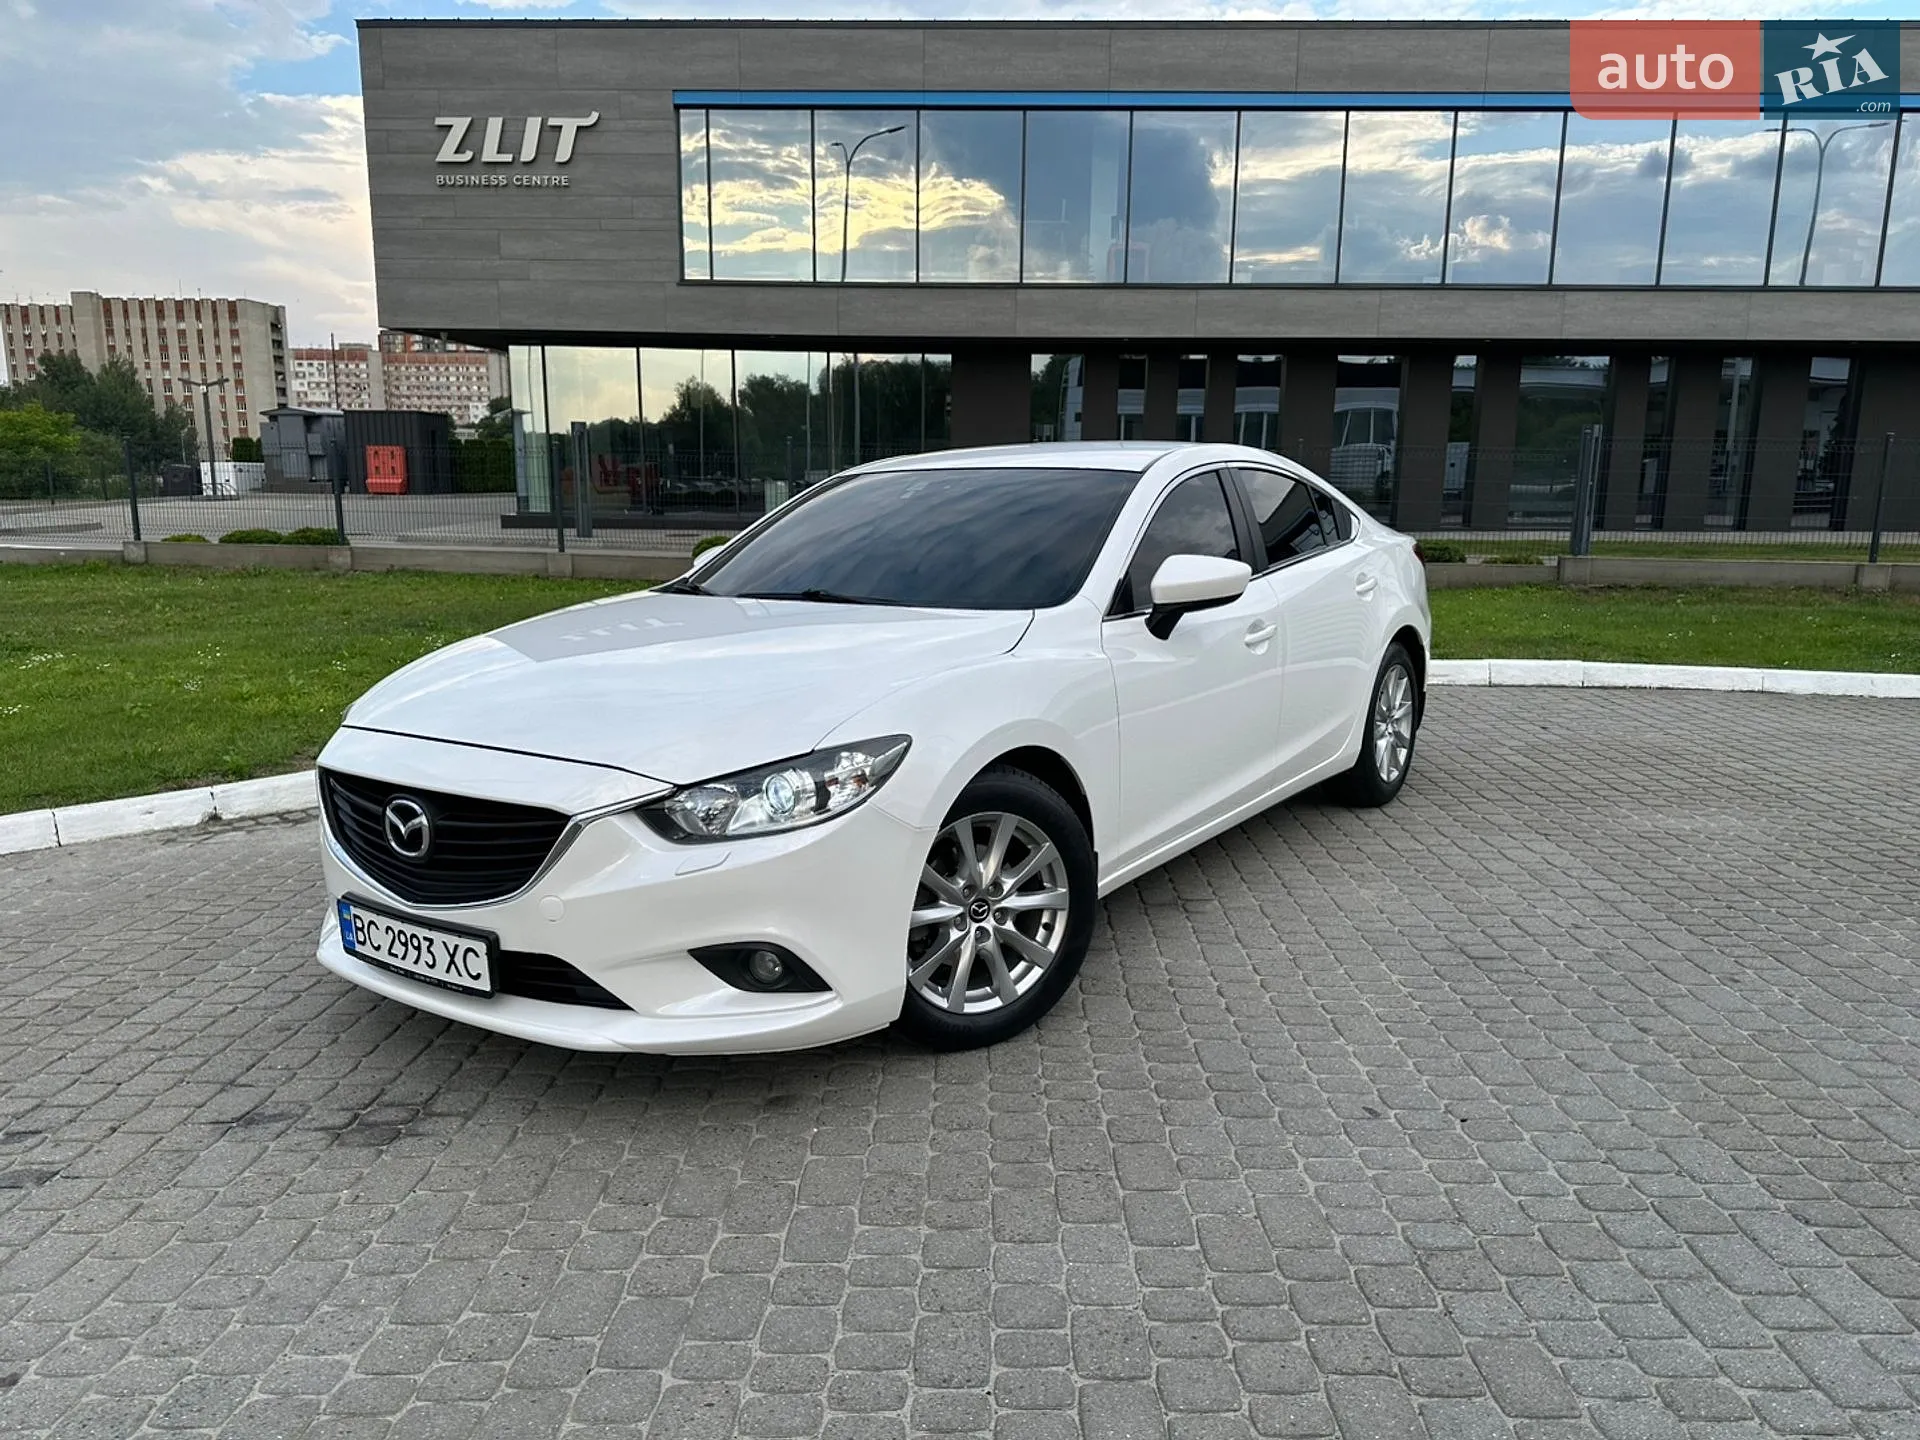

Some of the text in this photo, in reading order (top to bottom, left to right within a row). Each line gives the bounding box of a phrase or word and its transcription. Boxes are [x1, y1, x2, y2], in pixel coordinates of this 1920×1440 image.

[434, 110, 600, 163] ZLIT
[436, 174, 570, 187] BUSINESS CENTRE
[353, 913, 382, 952] BC
[385, 925, 437, 970] 2993
[442, 940, 482, 981] XC
